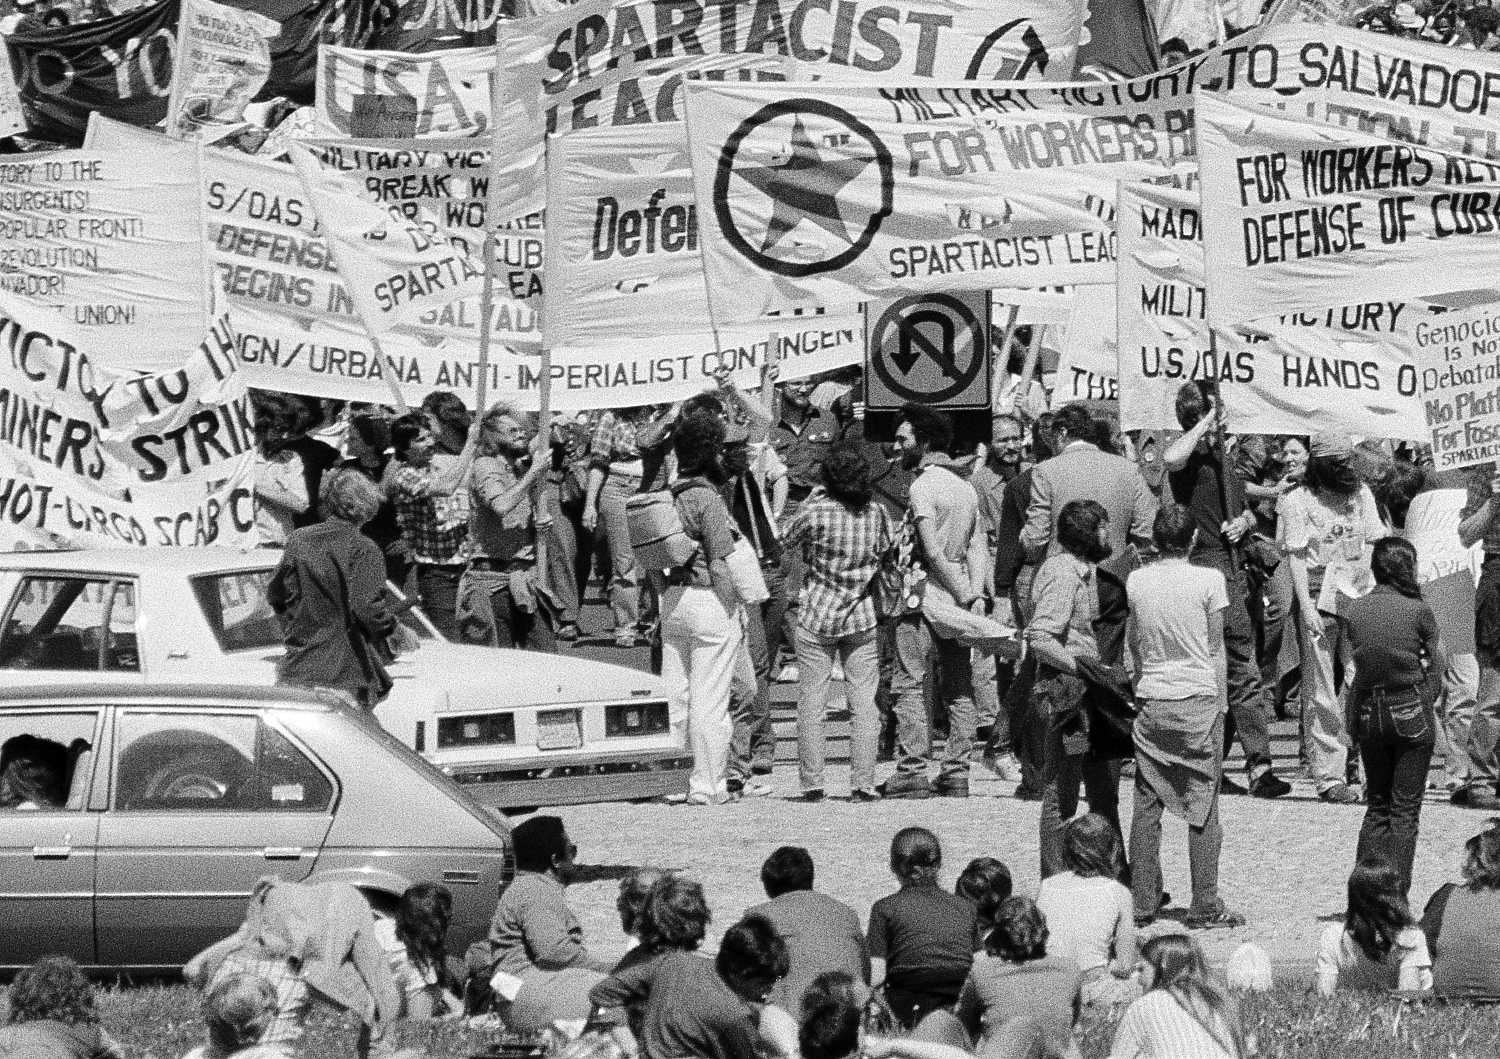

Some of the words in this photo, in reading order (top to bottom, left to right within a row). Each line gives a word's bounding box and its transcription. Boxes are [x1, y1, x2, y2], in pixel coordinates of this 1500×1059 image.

[1221, 43, 1279, 91] TO
[903, 128, 996, 177] FOR
[998, 112, 1158, 171] WORKERS
[44, 161, 63, 182] TO
[71, 159, 103, 181] THE
[364, 174, 450, 202] BREAK
[1236, 151, 1291, 207] FOR
[1301, 144, 1434, 198] WORKERS
[0, 190, 90, 212] SURGENTS!
[0, 219, 68, 240] POPULAR
[78, 217, 144, 239] FRONT!
[1243, 201, 1367, 267] DEFENSE
[1377, 195, 1416, 245] OF
[889, 234, 1054, 279] SPARTACIST
[75, 304, 136, 325] UNION!
[435, 354, 694, 392] ANTI-IMPERIALIST
[701, 328, 868, 379] CONTINGEN
[1282, 355, 1381, 392] HANDS
[1425, 398, 1454, 427] No
[131, 394, 255, 483] STRIK
[1431, 425, 1464, 454] For
